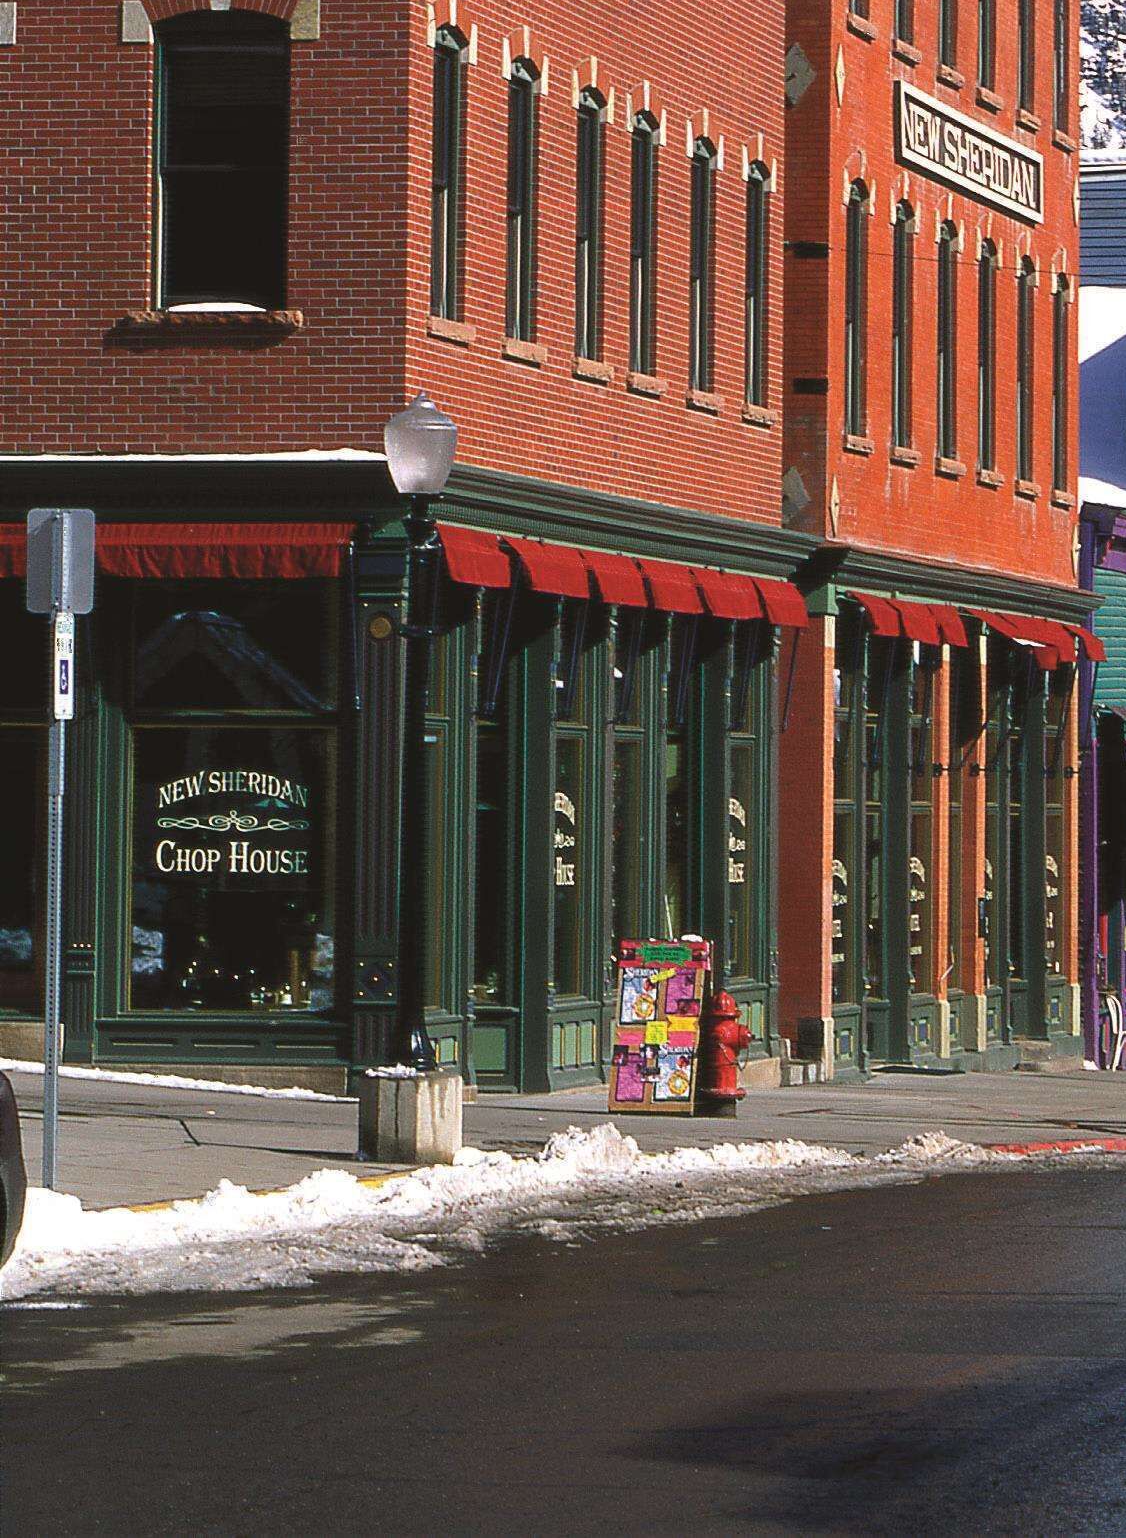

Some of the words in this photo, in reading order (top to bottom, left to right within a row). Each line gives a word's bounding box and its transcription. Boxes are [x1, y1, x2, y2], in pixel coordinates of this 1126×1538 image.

[902, 101, 941, 163] NEW
[944, 122, 1037, 209] SHERIDAN
[158, 770, 205, 809] NEW
[208, 770, 309, 808] SHERIDAN
